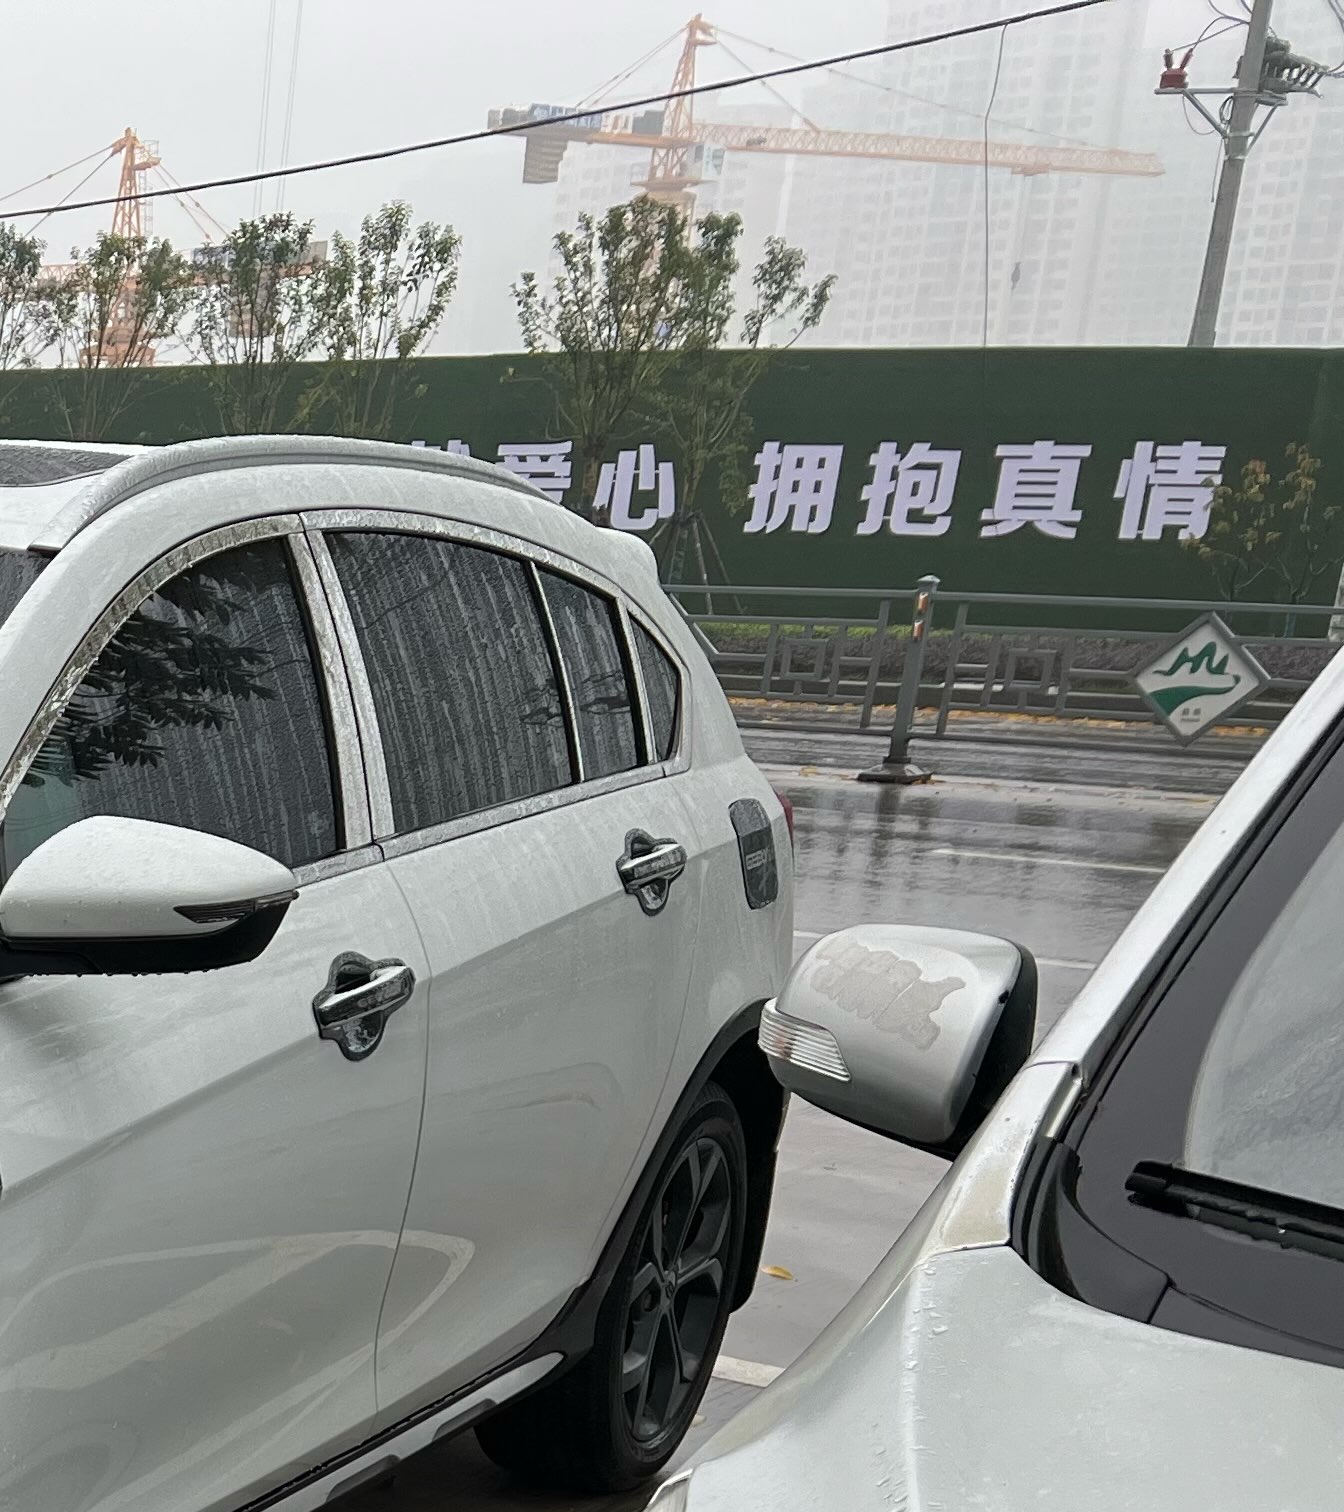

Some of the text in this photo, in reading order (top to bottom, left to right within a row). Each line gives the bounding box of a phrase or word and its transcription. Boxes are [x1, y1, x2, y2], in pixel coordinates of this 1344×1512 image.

[412, 438, 1228, 541] 爱心 拥抱真情
